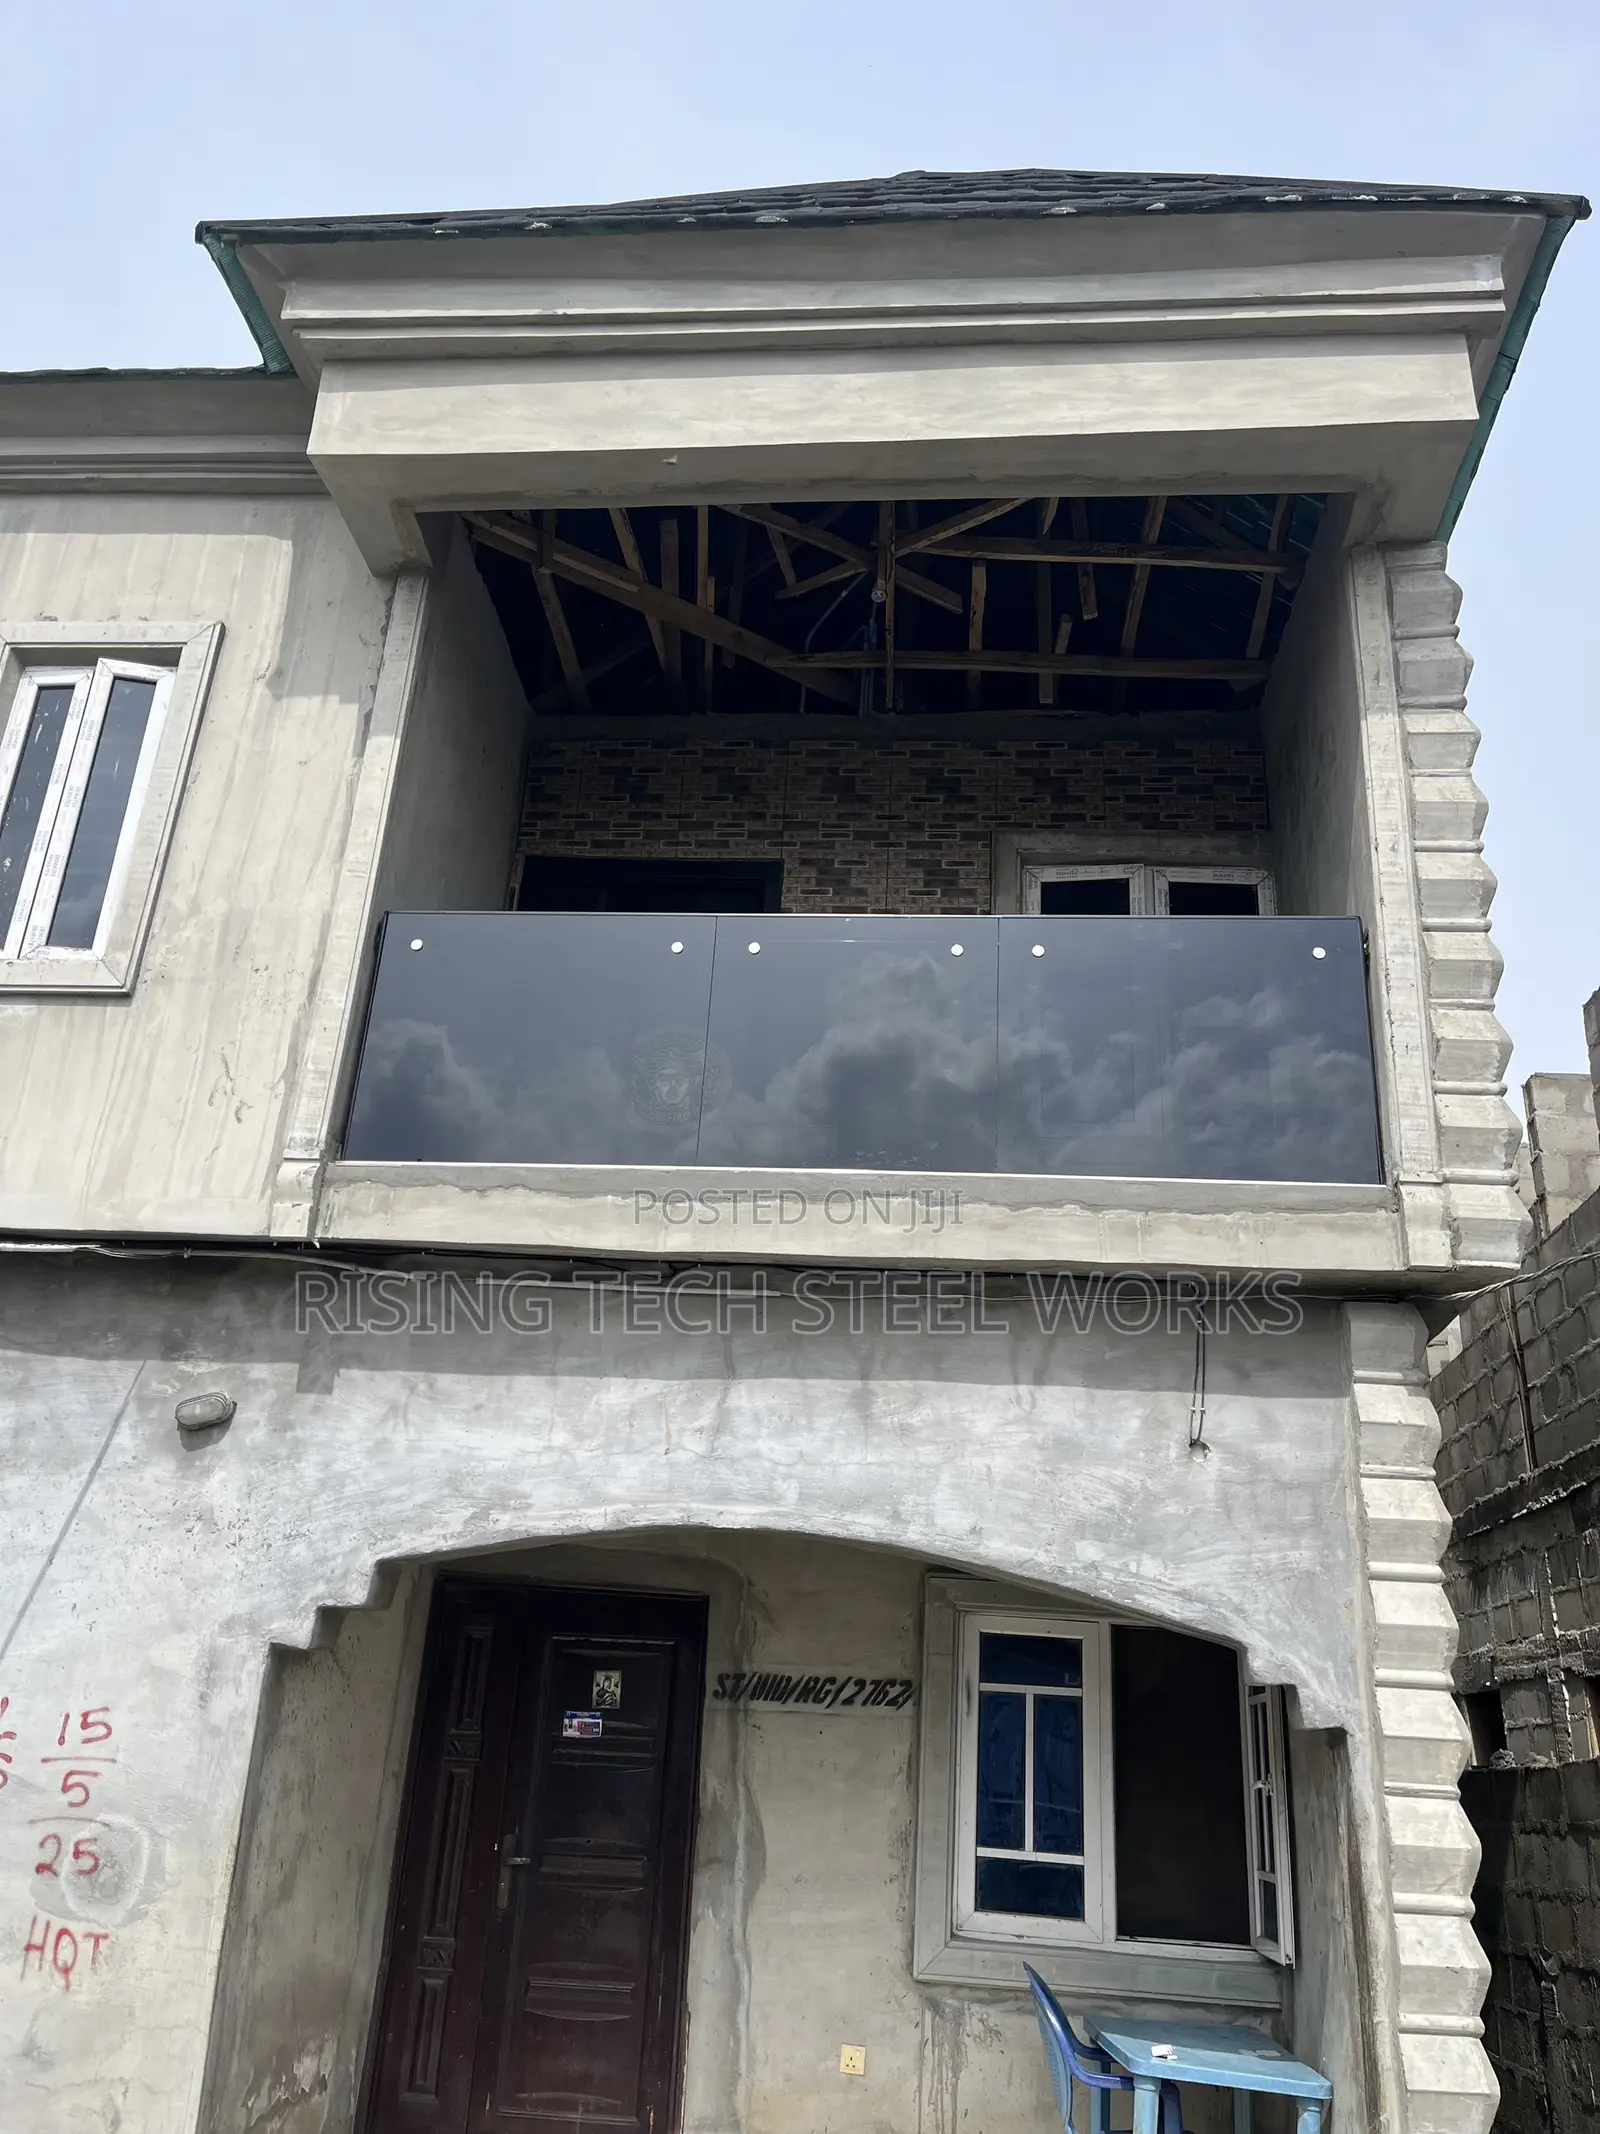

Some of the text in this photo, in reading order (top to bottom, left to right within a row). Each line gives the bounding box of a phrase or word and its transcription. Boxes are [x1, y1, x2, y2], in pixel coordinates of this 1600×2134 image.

[57, 1706, 112, 1746] 15
[61, 1769, 102, 1808] 5
[34, 1833, 101, 1878] 25
